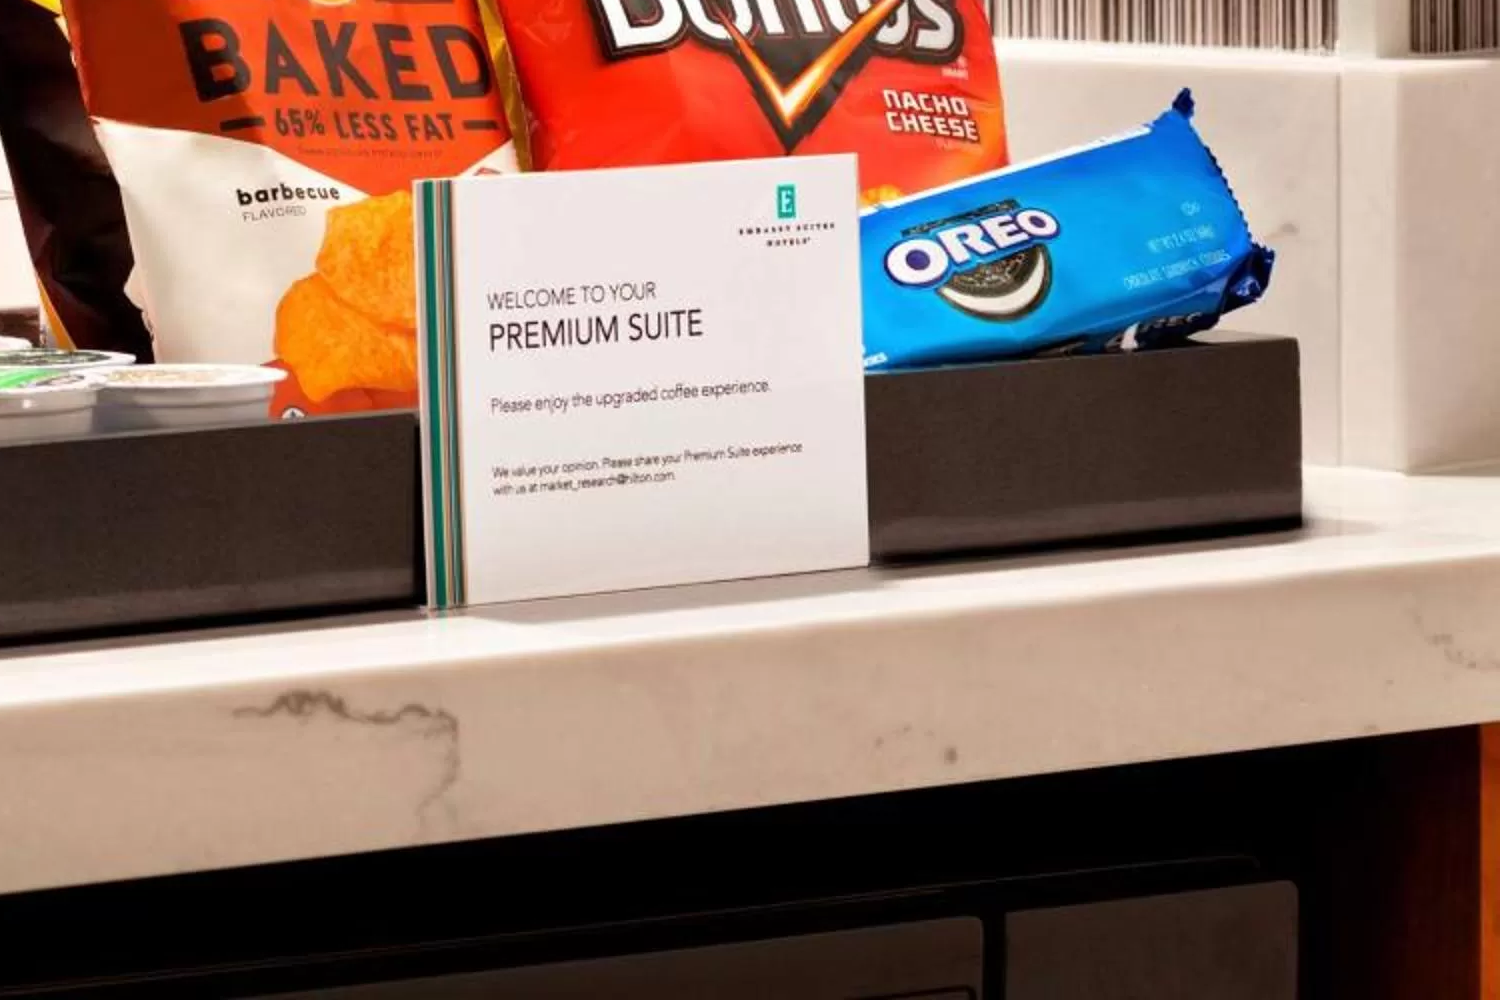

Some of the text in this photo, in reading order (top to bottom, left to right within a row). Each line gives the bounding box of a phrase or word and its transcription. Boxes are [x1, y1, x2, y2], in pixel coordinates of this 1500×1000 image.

[179, 17, 491, 103] BAKED
[883, 89, 969, 117] NACHO
[274, 108, 456, 142] 65% LESS FAT
[885, 111, 979, 141] CHEESE
[236, 182, 340, 206] barbecue
[242, 205, 307, 222] FLAVORED
[886, 209, 1059, 284] OREO
[487, 281, 657, 310] WELCOME TO YOUR
[490, 308, 703, 353] PREMIUM SUITE
[491, 380, 770, 414] Please enjoy the upgraded coffee experience.
[492, 465, 509, 478] We
[512, 464, 537, 478] value
[539, 463, 560, 478] your
[602, 456, 633, 469] Please
[635, 454, 660, 467] share
[662, 453, 682, 467] your
[684, 448, 725, 463] Premium
[727, 445, 751, 460] Suite
[752, 441, 803, 459] experience
[493, 485, 514, 496] with
[516, 485, 527, 495] us
[528, 482, 538, 494] at
